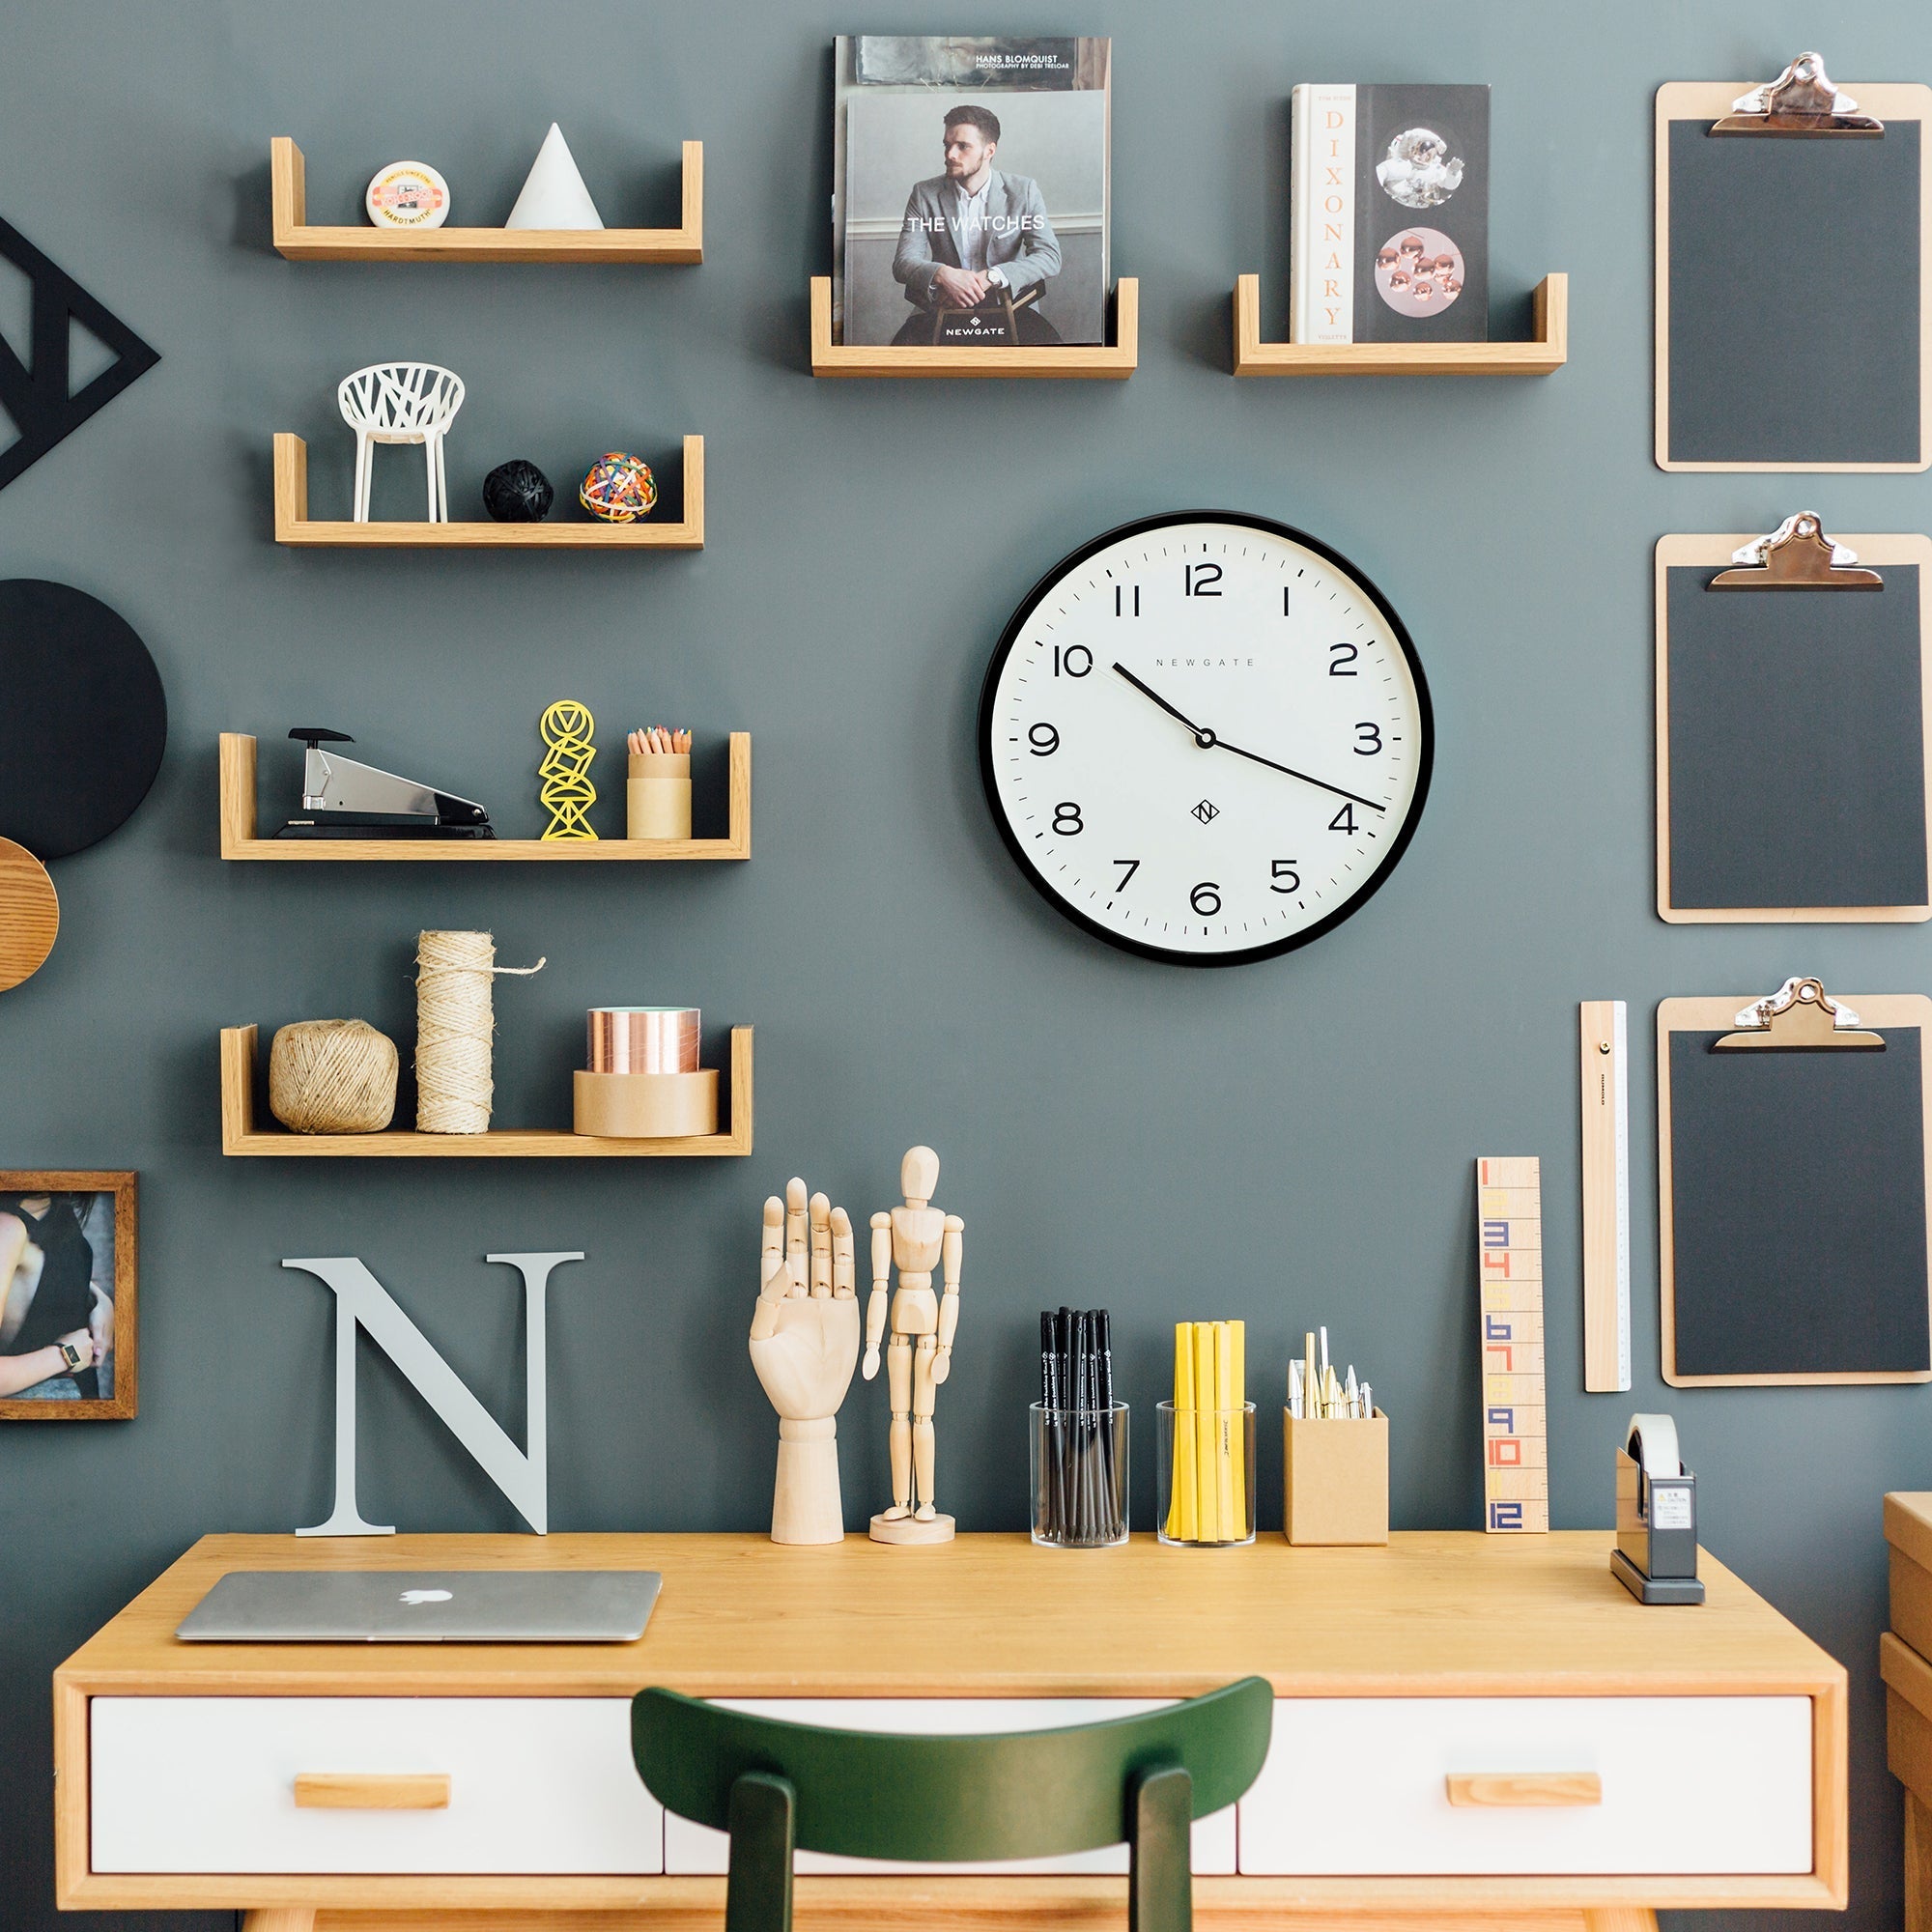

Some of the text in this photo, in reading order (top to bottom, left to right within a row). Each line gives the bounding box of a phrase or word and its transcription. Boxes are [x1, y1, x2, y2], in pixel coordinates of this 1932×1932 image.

[1005, 54, 1058, 64] BLOMQUIST
[908, 215, 1045, 232] THE WATCHES
[1324, 111, 1344, 326] DIXONARY
[946, 327, 1005, 336] NEWGATE
[1186, 563, 1222, 596] 12
[1116, 585, 1139, 616] 11
[1285, 587, 1289, 616] 1
[1055, 645, 1093, 677] 10
[1329, 643, 1357, 675] 2
[1029, 723, 1059, 756] 9
[1354, 723, 1381, 755] 3
[1052, 803, 1083, 836] 8
[1328, 803, 1358, 835] 4
[1114, 861, 1140, 892] 7
[1270, 860, 1299, 894] 5
[1190, 882, 1221, 916] 6
[1482, 1160, 1488, 1185] 1
[1484, 1222, 1509, 1246] 3
[1485, 1253, 1509, 1277] 4
[1486, 1315, 1511, 1340] 6
[1487, 1346, 1512, 1371] 7
[282, 1251, 584, 1536] N
[1489, 1408, 1513, 1434] 9
[1489, 1439, 1520, 1465] 10
[1491, 1503, 1522, 1529] 12
